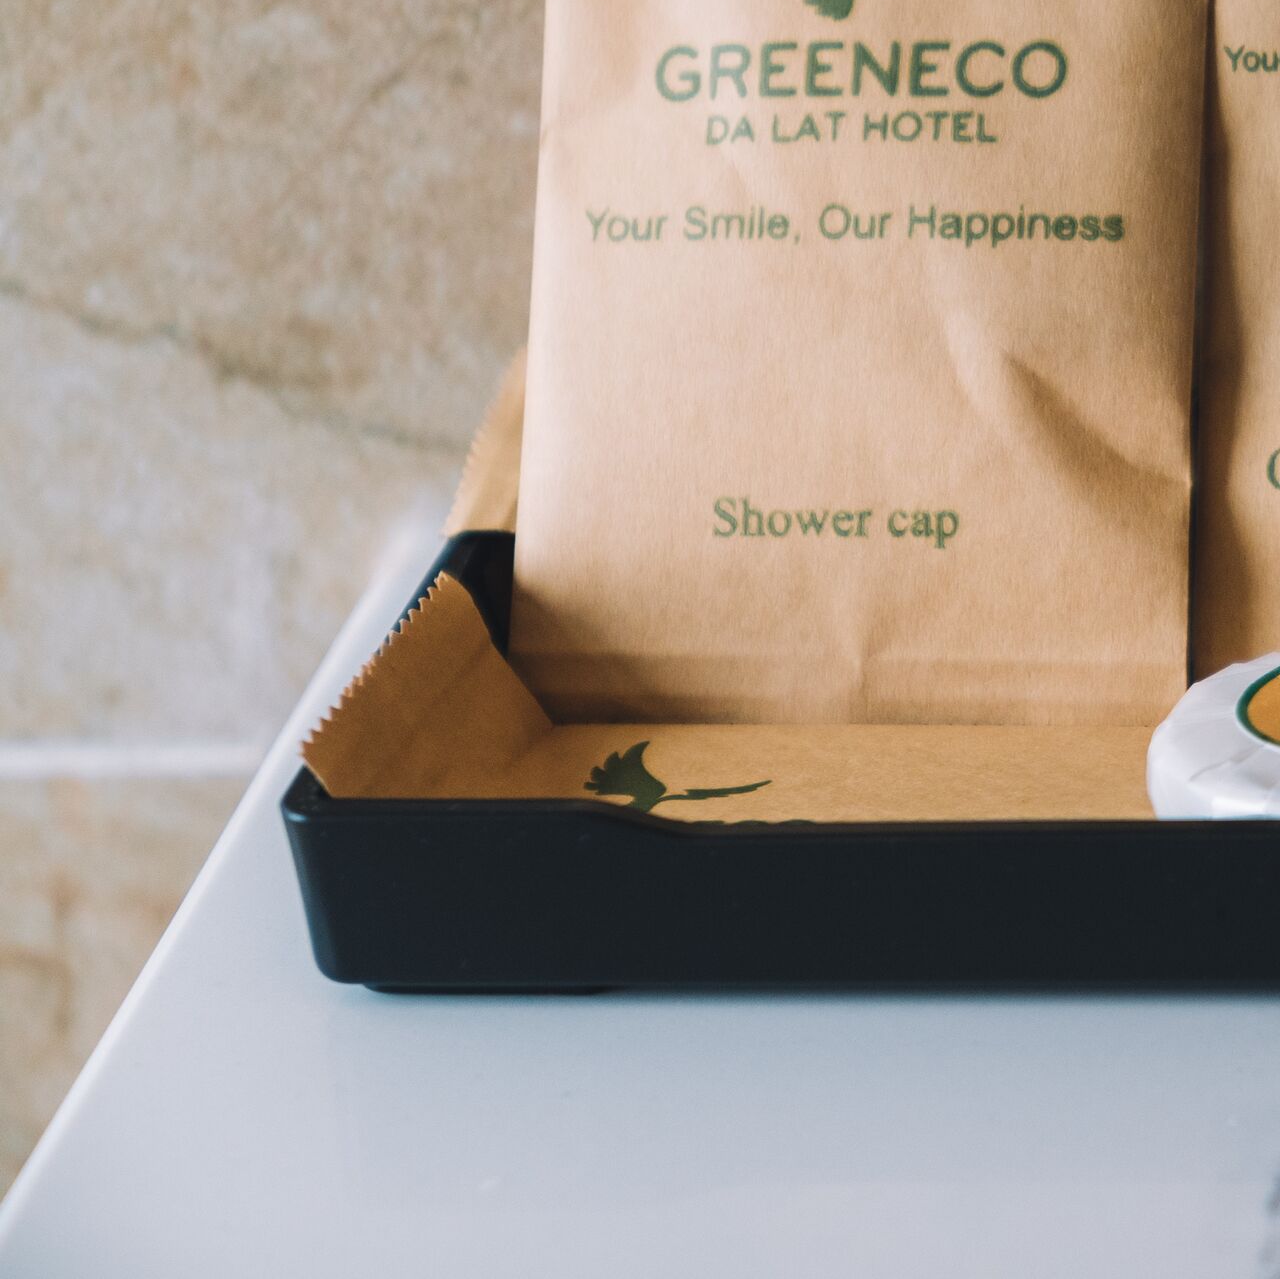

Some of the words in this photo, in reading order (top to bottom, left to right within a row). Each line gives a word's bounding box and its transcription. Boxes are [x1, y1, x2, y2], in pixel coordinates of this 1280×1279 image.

[655, 40, 1068, 102] GREENECO
[706, 115, 754, 145] DA
[772, 112, 845, 142] LAT
[862, 110, 997, 144] HOTEL
[585, 209, 667, 242] Your
[684, 206, 800, 244] Smile,
[819, 204, 891, 240] Our
[907, 204, 1126, 248] Happiness
[713, 496, 872, 538] Shower
[888, 508, 960, 549] cap
